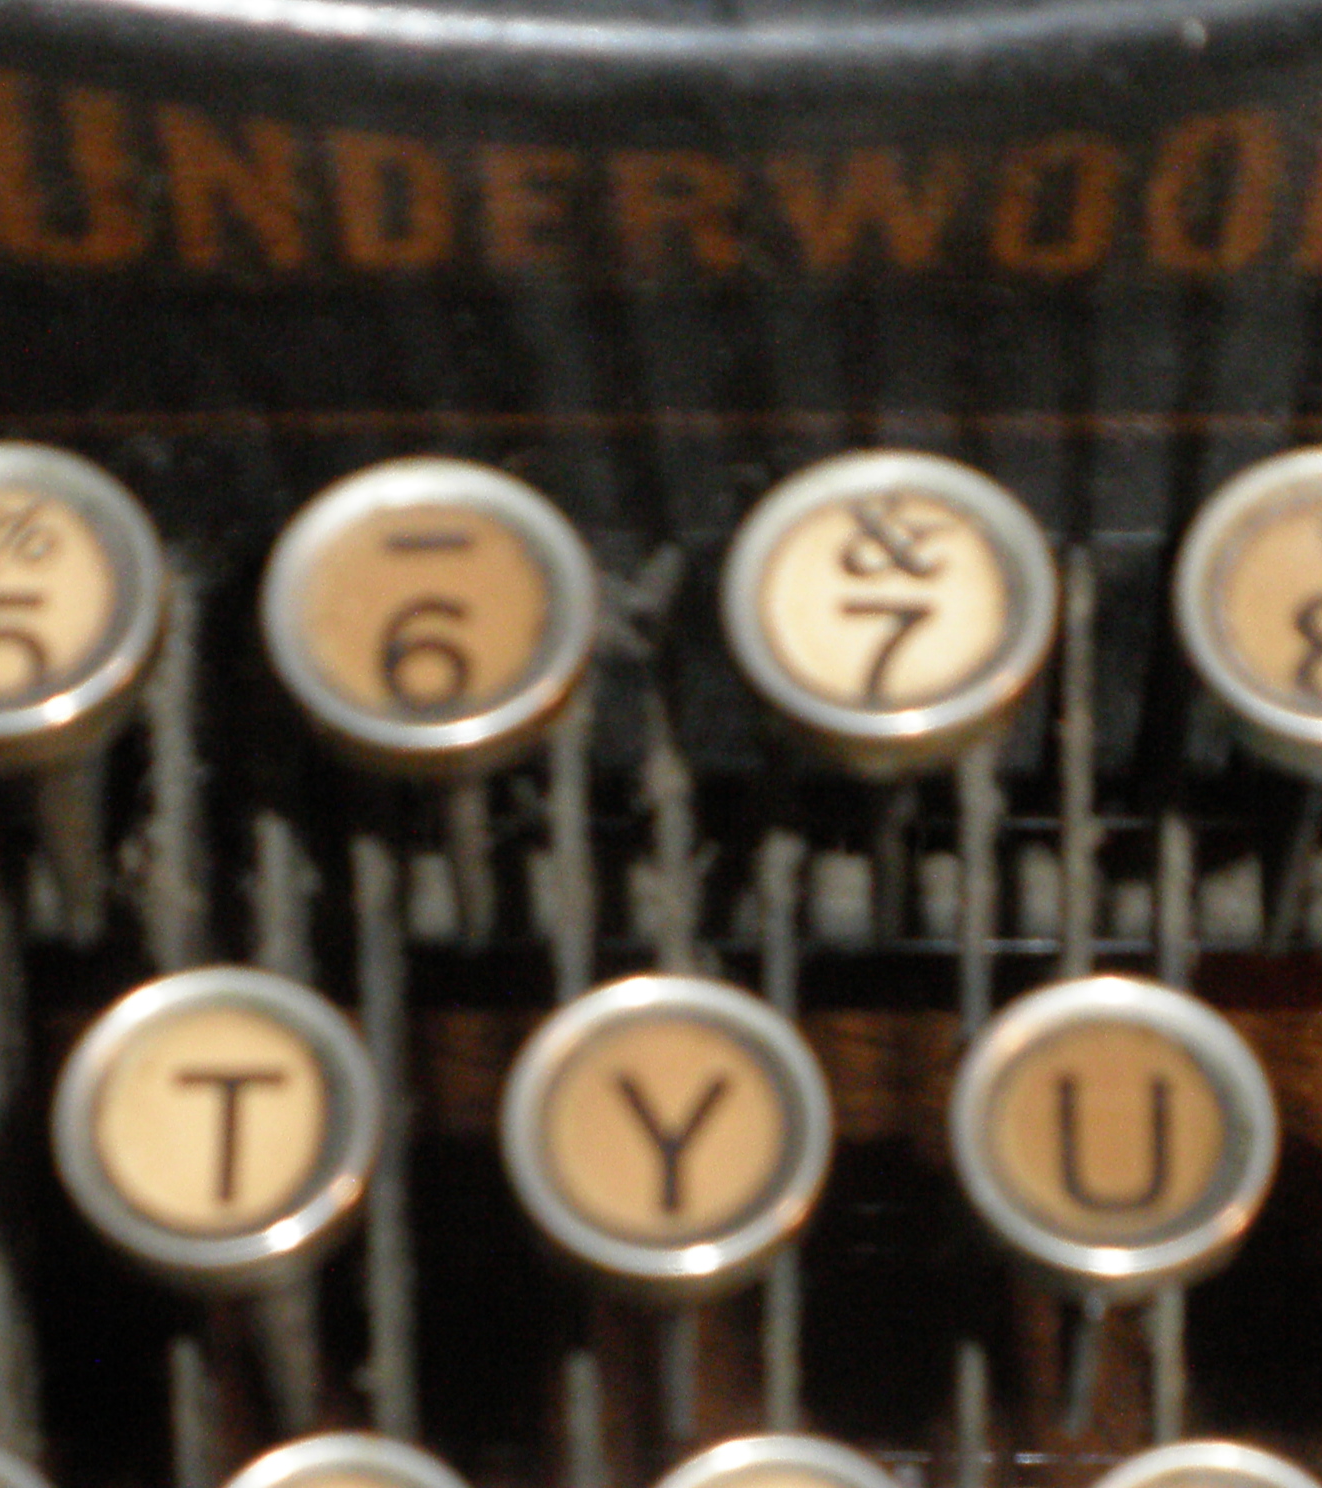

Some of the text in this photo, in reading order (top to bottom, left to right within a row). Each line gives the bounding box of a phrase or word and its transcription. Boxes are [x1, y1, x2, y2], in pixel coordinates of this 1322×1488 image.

[837, 495, 952, 580] &
[380, 598, 469, 712] 6
[837, 597, 935, 703] 7
[169, 1066, 291, 1207] T
[613, 1072, 733, 1215] Y
[1057, 1072, 1173, 1214] U
